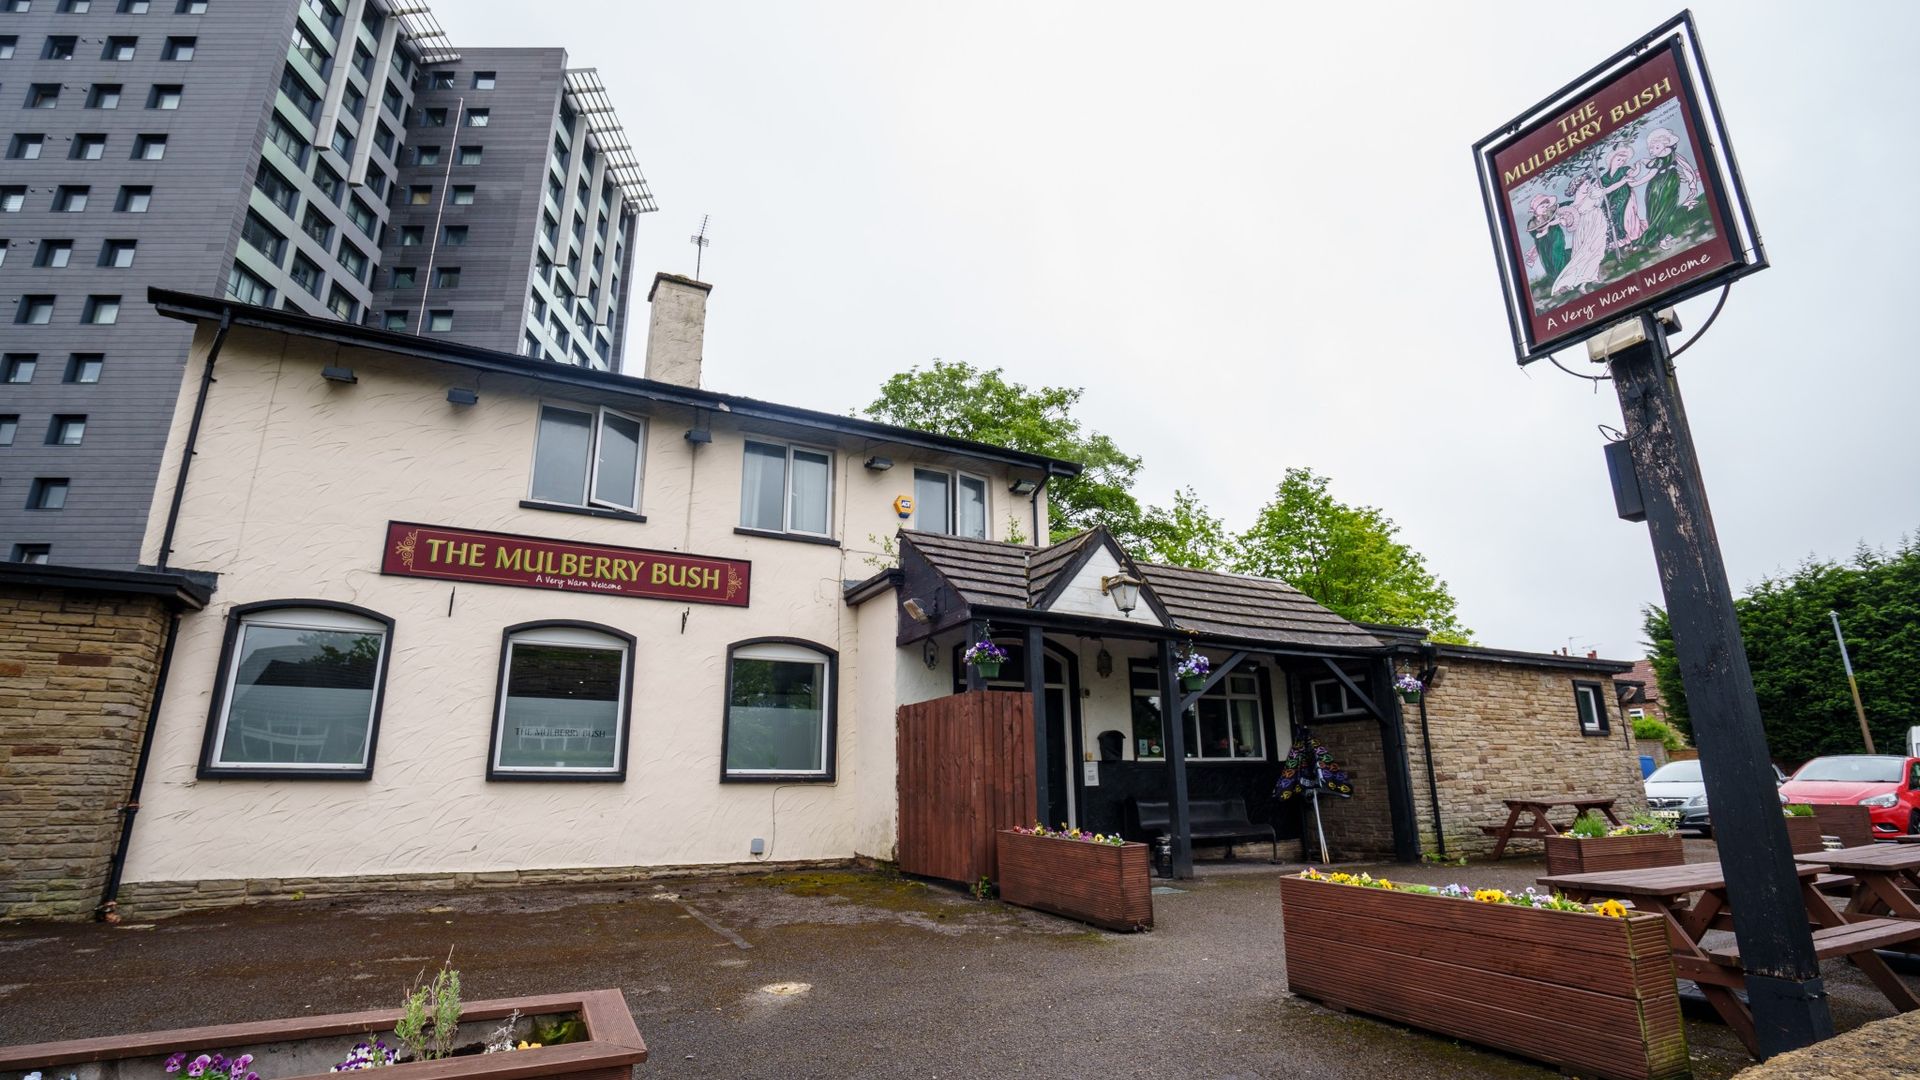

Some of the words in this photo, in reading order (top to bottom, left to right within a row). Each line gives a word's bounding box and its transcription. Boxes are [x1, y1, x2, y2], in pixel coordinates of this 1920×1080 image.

[1504, 115, 1603, 186] MULBERRY
[1609, 77, 1672, 124] BUSH
[1556, 101, 1599, 134] THE
[1547, 318, 1558, 331] A
[1561, 303, 1595, 323] Very
[1599, 283, 1641, 307] Warm
[1644, 253, 1711, 287] Welcome
[426, 539, 486, 567] THE
[494, 546, 645, 581] MULBERRY
[651, 563, 720, 590] BUSH
[536, 574, 543, 583] A
[545, 577, 564, 588] Very
[567, 578, 588, 587] Warm
[590, 580, 622, 590] Welcome
